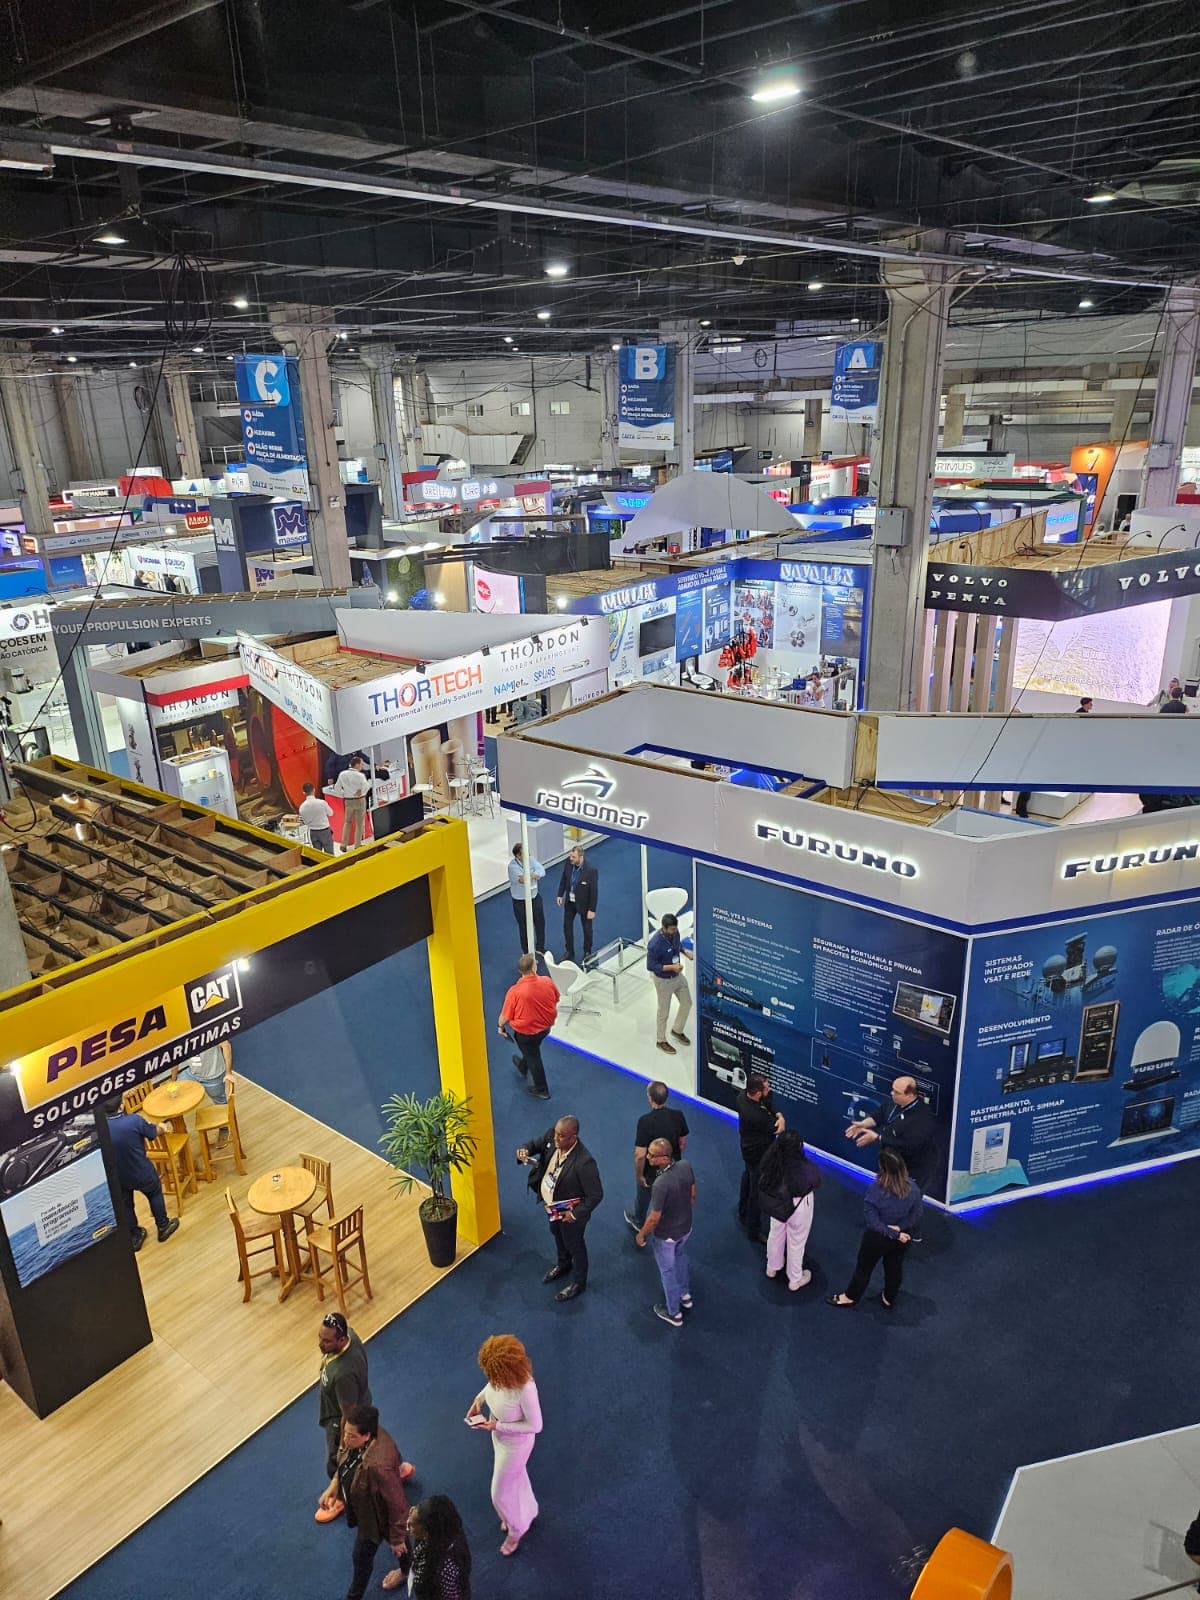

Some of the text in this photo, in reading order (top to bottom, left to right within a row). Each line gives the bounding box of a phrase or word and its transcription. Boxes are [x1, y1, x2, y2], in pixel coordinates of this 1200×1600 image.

[635, 348, 658, 380] B
[848, 348, 868, 370] A
[256, 360, 282, 405] C
[936, 462, 973, 472] RIMUS
[931, 573, 1008, 588] VOLVO
[930, 590, 1007, 606] PENTA
[53, 615, 212, 634] YOUR PROPULSION EXPERTS
[30, 633, 46, 643] EM
[501, 630, 579, 662] THORDON
[368, 664, 482, 715] THORTECH
[370, 689, 483, 727] Environmental Friendly Solutions
[537, 788, 648, 829] radiomar
[758, 823, 916, 878] FURUNO
[712, 913, 746, 928] PORTUÁRIOS
[746, 917, 773, 930] SISTEMAS
[1156, 926, 1182, 936] RADAR
[1183, 924, 1193, 932] DE
[822, 946, 849, 960] PACOTES
[850, 953, 892, 972] ECONÔMICOS
[851, 948, 887, 964] PORTUÁRIA
[894, 962, 922, 975] PRIVADA
[984, 961, 1034, 976] INTEGRADOS
[985, 954, 1023, 967] SISTEMAS
[984, 974, 1003, 984] VSAT
[1011, 970, 1032, 979] REDE
[190, 974, 232, 1013] CAT
[978, 1015, 1051, 1034] DESENVOLVIMENTO
[46, 1006, 167, 1083] PESA
[742, 1037, 752, 1045] LUZ
[32, 1015, 241, 1130] SOLUÇÕES MARÍTIMAS
[970, 1099, 1031, 1116] RASTREAMENTO,
[970, 1099, 1065, 1124] TELEMETRIA, LRIT, SIMMAP
